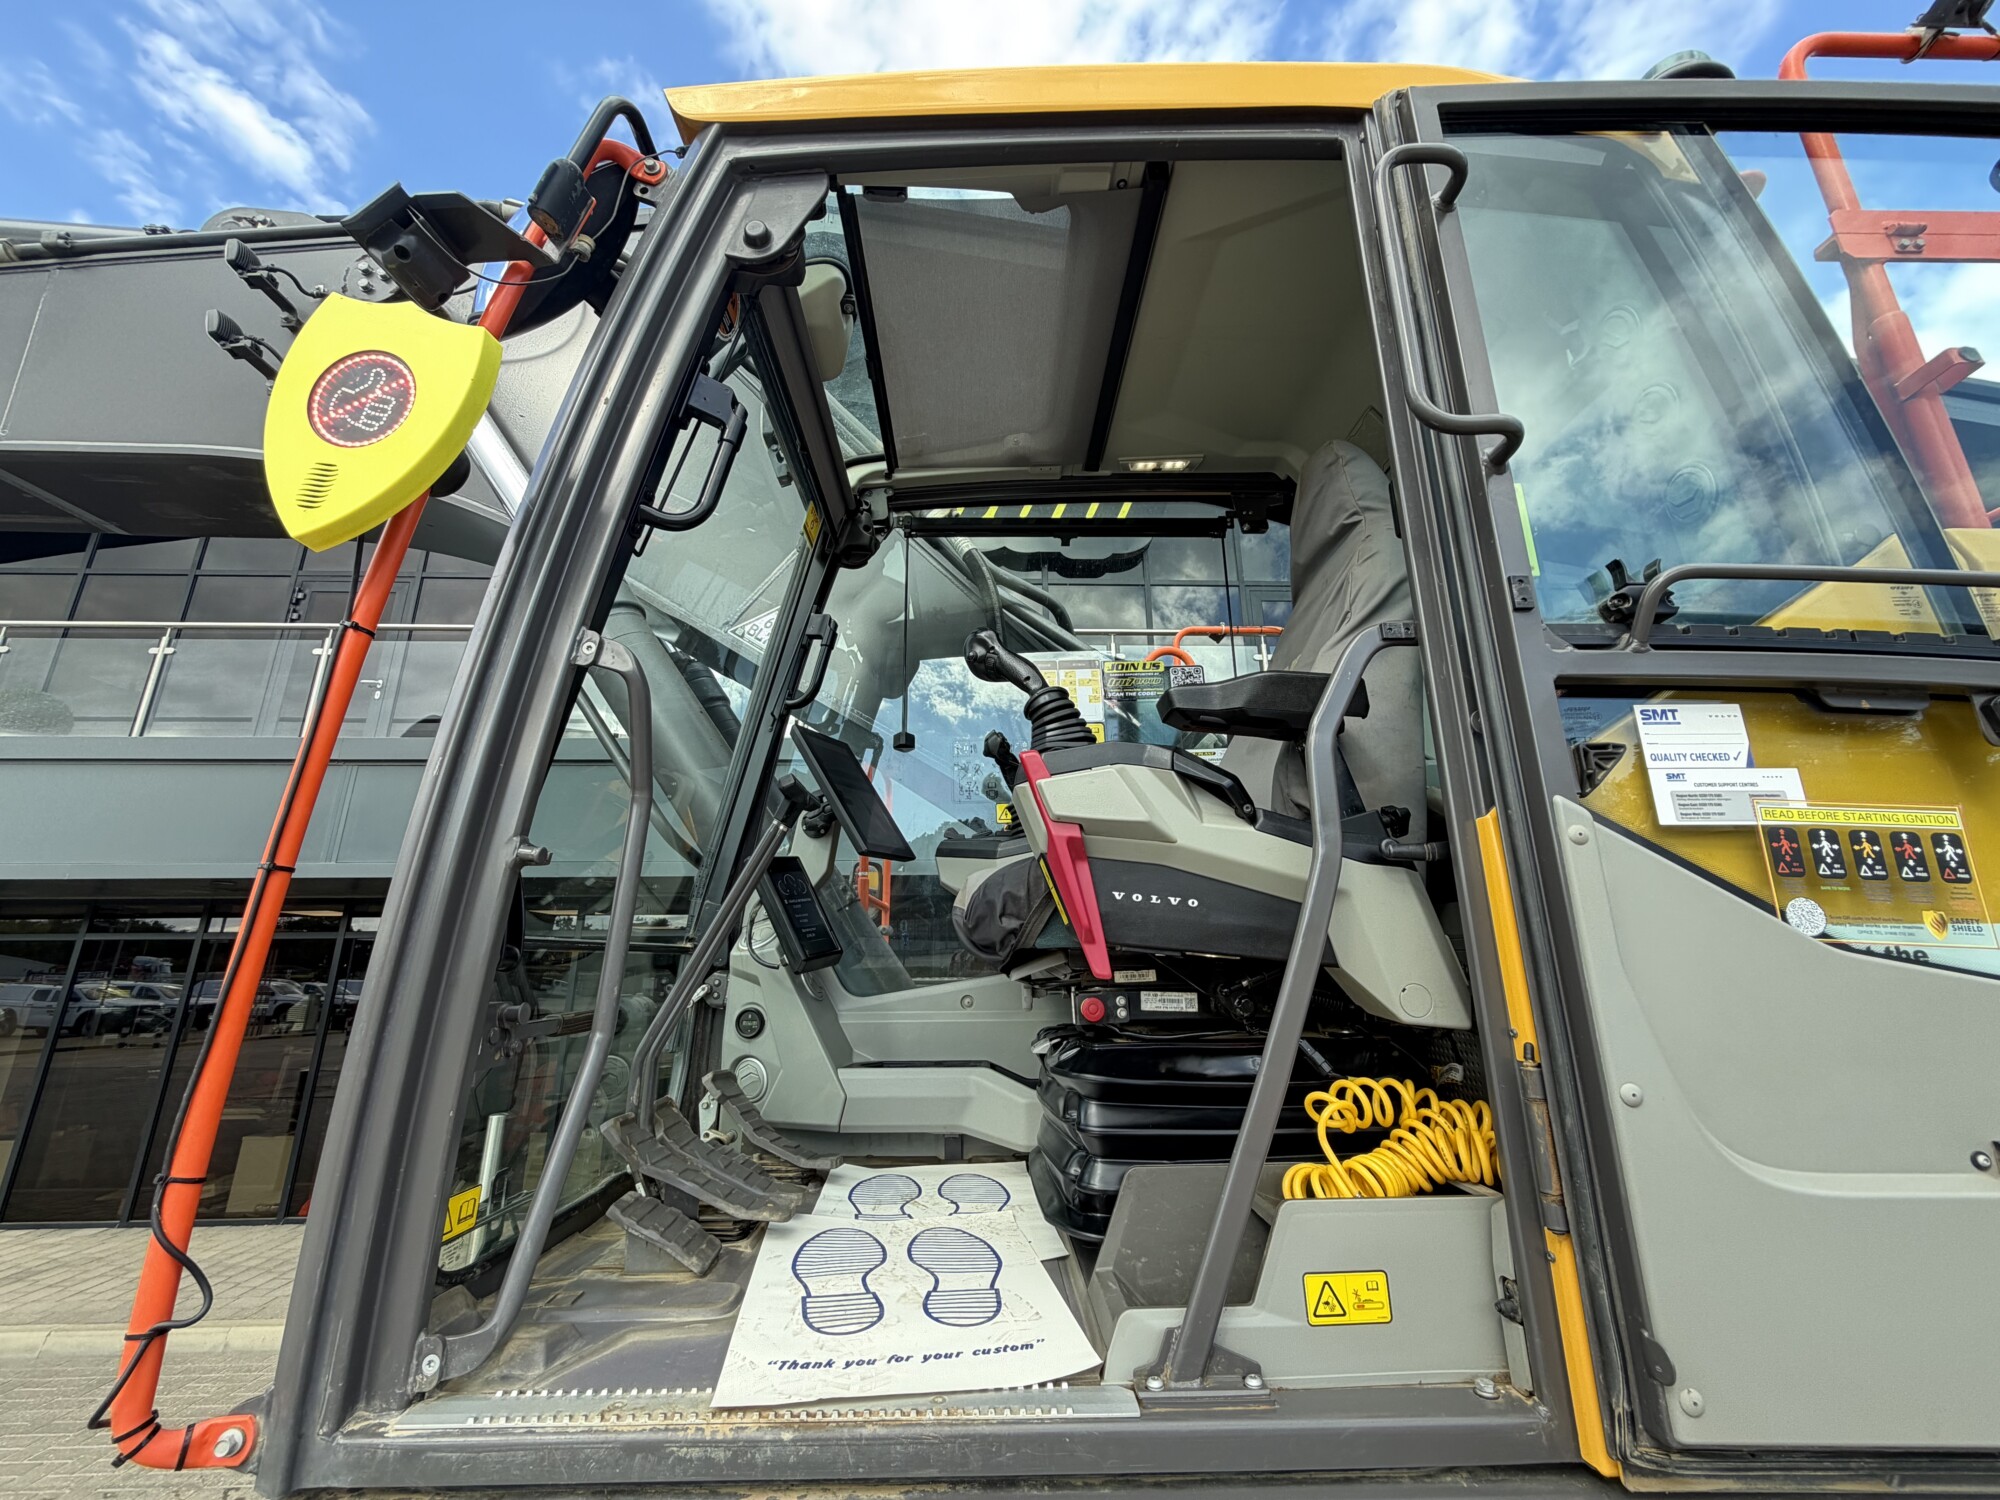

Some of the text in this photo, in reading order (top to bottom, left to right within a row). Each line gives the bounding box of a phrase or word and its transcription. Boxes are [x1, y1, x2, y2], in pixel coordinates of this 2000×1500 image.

[1106, 662, 1161, 671] JOIN US
[1639, 708, 1679, 721] SMT
[1650, 752, 1731, 762] QUALITY CHECKED
[1665, 772, 1686, 780] SMT
[1764, 809, 1955, 825] READ BEFORE STARTING IGNITION
[1112, 891, 1199, 908] VOLVO
[1949, 917, 1980, 925] SAFETY
[1951, 925, 1984, 933] SHIELD
[842, 1358, 878, 1370] you
[886, 1353, 914, 1364] for
[920, 1351, 964, 1364] your
